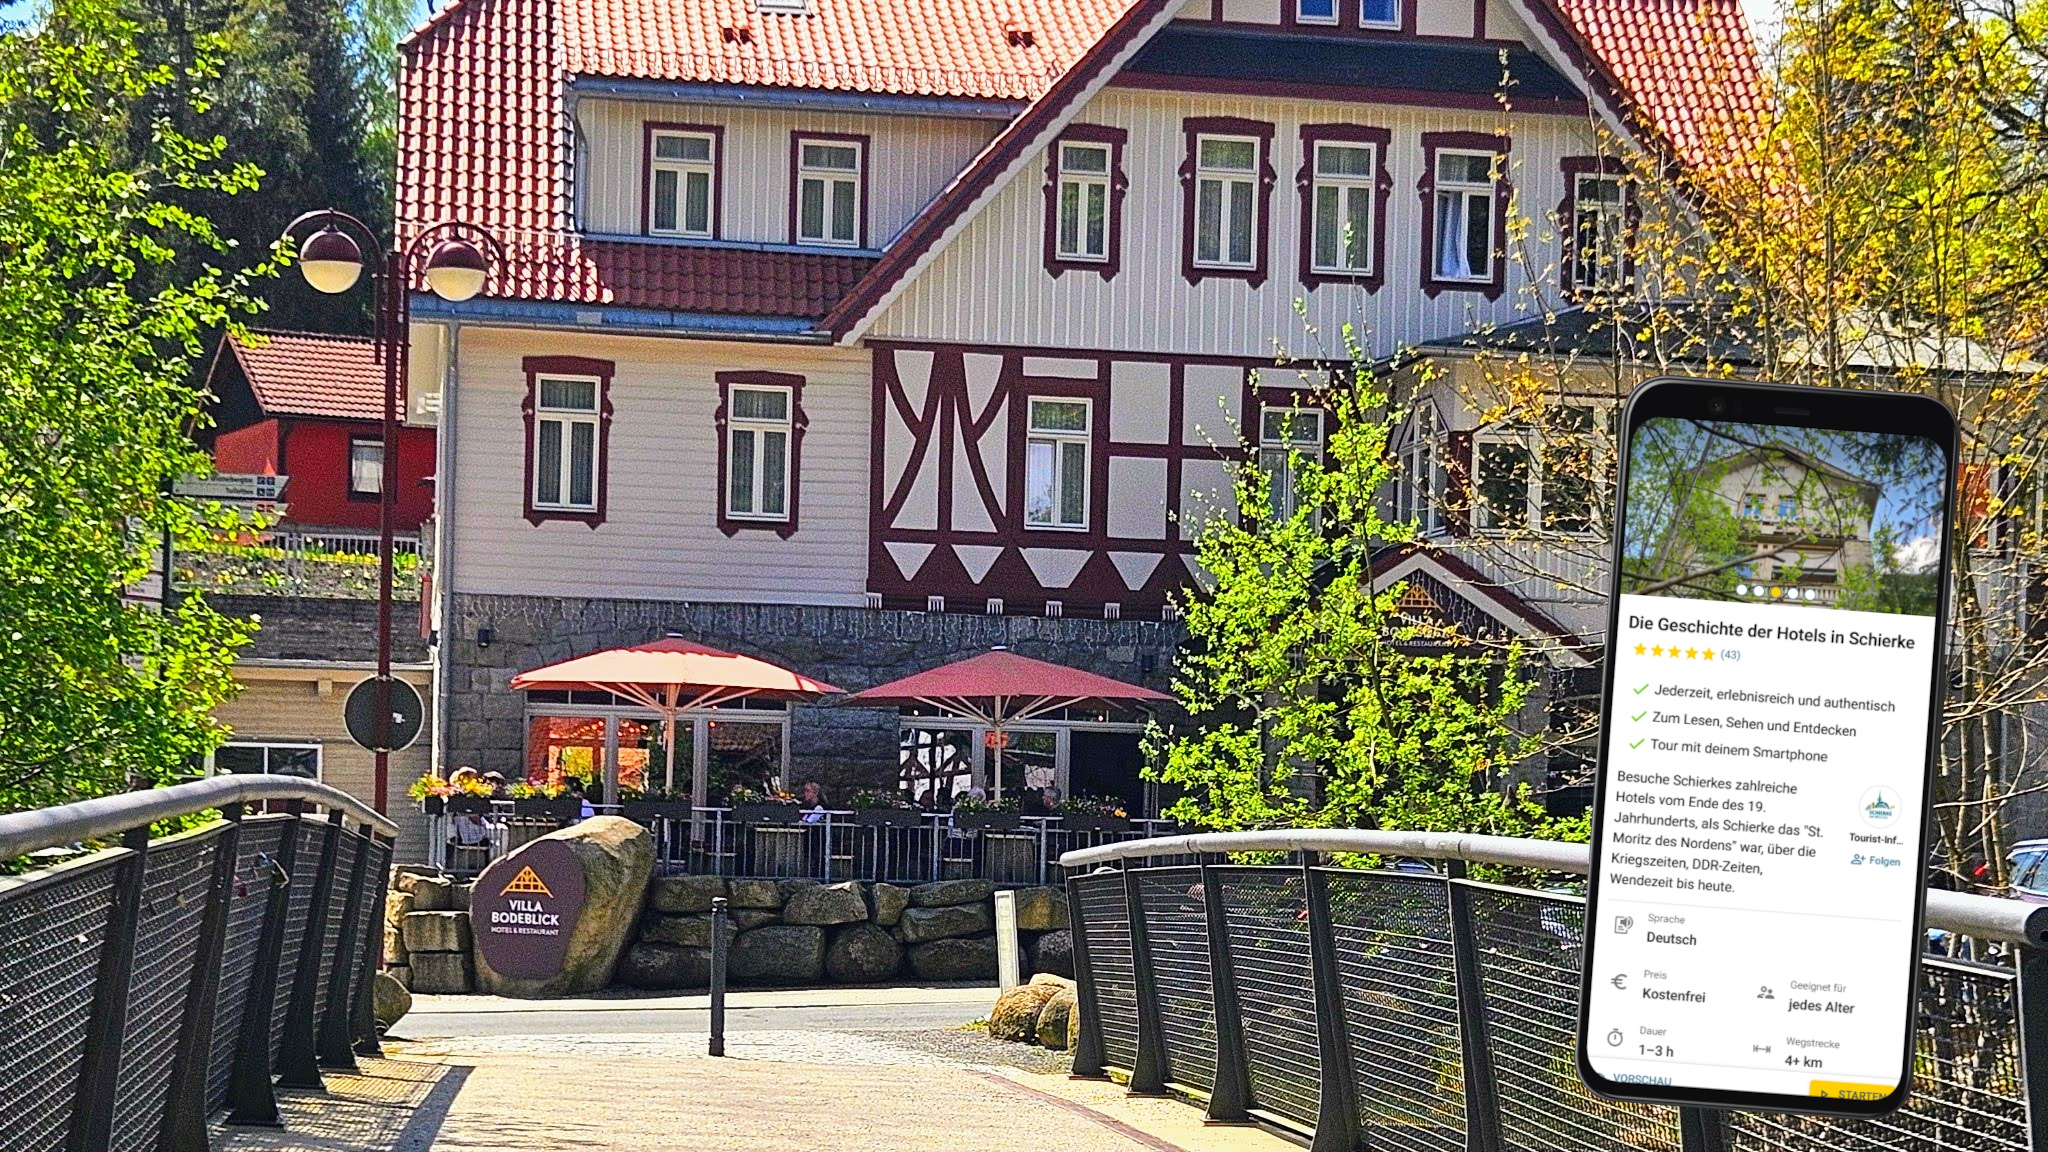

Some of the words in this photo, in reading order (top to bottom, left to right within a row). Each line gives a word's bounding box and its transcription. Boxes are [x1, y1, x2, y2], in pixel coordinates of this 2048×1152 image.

[1629, 615, 1654, 630] Die
[1657, 617, 1744, 637] Geschichte
[1747, 623, 1773, 639] der
[1776, 626, 1827, 643] Hotels
[1830, 630, 1845, 645] in
[1848, 631, 1916, 650] Schierke
[1720, 649, 1741, 662] (43)
[1654, 684, 1714, 701] Jederzeit,
[1716, 689, 1795, 706] erlebnisreich
[1798, 695, 1821, 708] und
[1823, 696, 1896, 713] authentisch
[1652, 711, 1681, 724] Zum
[1683, 713, 1723, 729] Lesen,
[1725, 716, 1764, 731] Sehen
[1766, 719, 1790, 732] und
[1793, 721, 1857, 737] Entdecken
[1650, 738, 1679, 751] Tour
[1681, 740, 1702, 753] mit
[1704, 742, 1750, 757] deinem
[1752, 745, 1829, 763] Smartphone
[1617, 770, 1670, 786] Besuche
[1673, 774, 1732, 790] Schierkes
[1735, 779, 1798, 795] zahlreiche
[1615, 791, 1656, 805] Hotels
[1658, 796, 1685, 807] vom
[1688, 796, 1719, 809] Ende
[1721, 798, 1744, 811] des
[1748, 801, 1766, 813] 19.
[1613, 811, 1698, 830] Jahrhunderts,
[1701, 816, 1720, 830] als
[1722, 819, 1775, 835] Schierke
[1777, 823, 1801, 836] das
[1803, 824, 1824, 838] "St.
[1612, 831, 1652, 846] Moritz
[1654, 834, 1677, 848] des
[1680, 836, 1737, 852] Nordens"
[1739, 843, 1764, 857] war,
[1766, 843, 1796, 856] über
[1797, 845, 1817, 858] die
[1611, 853, 1689, 871] Kriegszeiten,
[1692, 858, 1763, 876] DDR-Zeiten,
[1869, 856, 1901, 868] Folgen
[1609, 873, 1674, 889] Wendezeit
[1676, 877, 1695, 890] bis
[1697, 879, 1735, 893] heute.
[508, 899, 543, 912] VILLA
[491, 911, 560, 926] BODEBLICK
[1648, 913, 1686, 926] Sprache
[490, 926, 513, 934] HOTEL
[518, 927, 559, 936] RESTAURANT
[1646, 931, 1697, 946] Deutsch
[1643, 970, 1668, 981] Preis
[1790, 980, 1832, 994] Geeignet
[1833, 982, 1847, 994] für
[1642, 987, 1706, 1003] Kostenfrei
[1787, 998, 1822, 1014] jedes
[1825, 1001, 1855, 1014] Alter
[1639, 1026, 1667, 1037] Dauer
[1786, 1037, 1841, 1050] Wegstrecke
[1666, 1046, 1674, 1058] h
[1784, 1055, 1802, 1067] 4+
[1804, 1056, 1823, 1069] km
[1613, 1073, 1672, 1087] VORSCHAU
